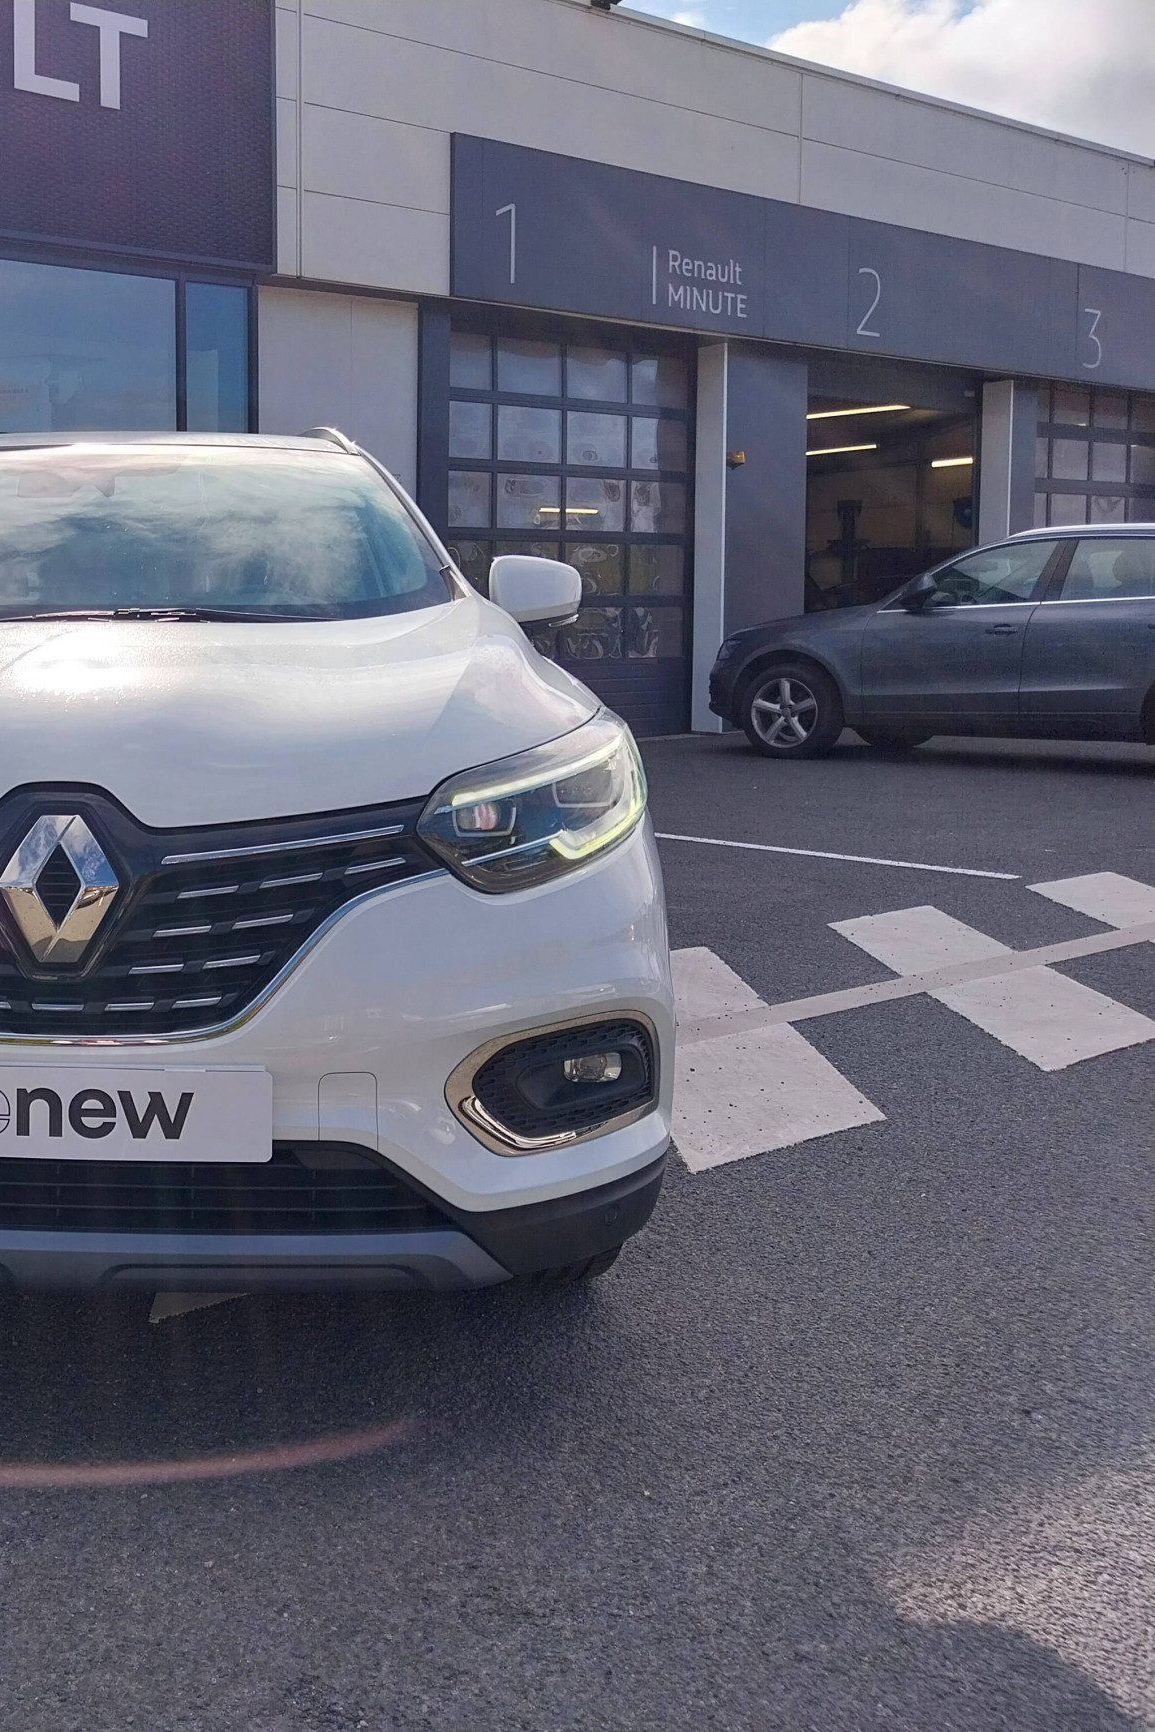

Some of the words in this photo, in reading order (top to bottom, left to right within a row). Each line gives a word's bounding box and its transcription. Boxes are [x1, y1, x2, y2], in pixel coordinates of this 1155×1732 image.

[495, 203, 516, 284] 1
[667, 249, 743, 285] Renault
[667, 283, 748, 318] MINUTE
[856, 267, 881, 338] 2
[1082, 308, 1102, 369] 3
